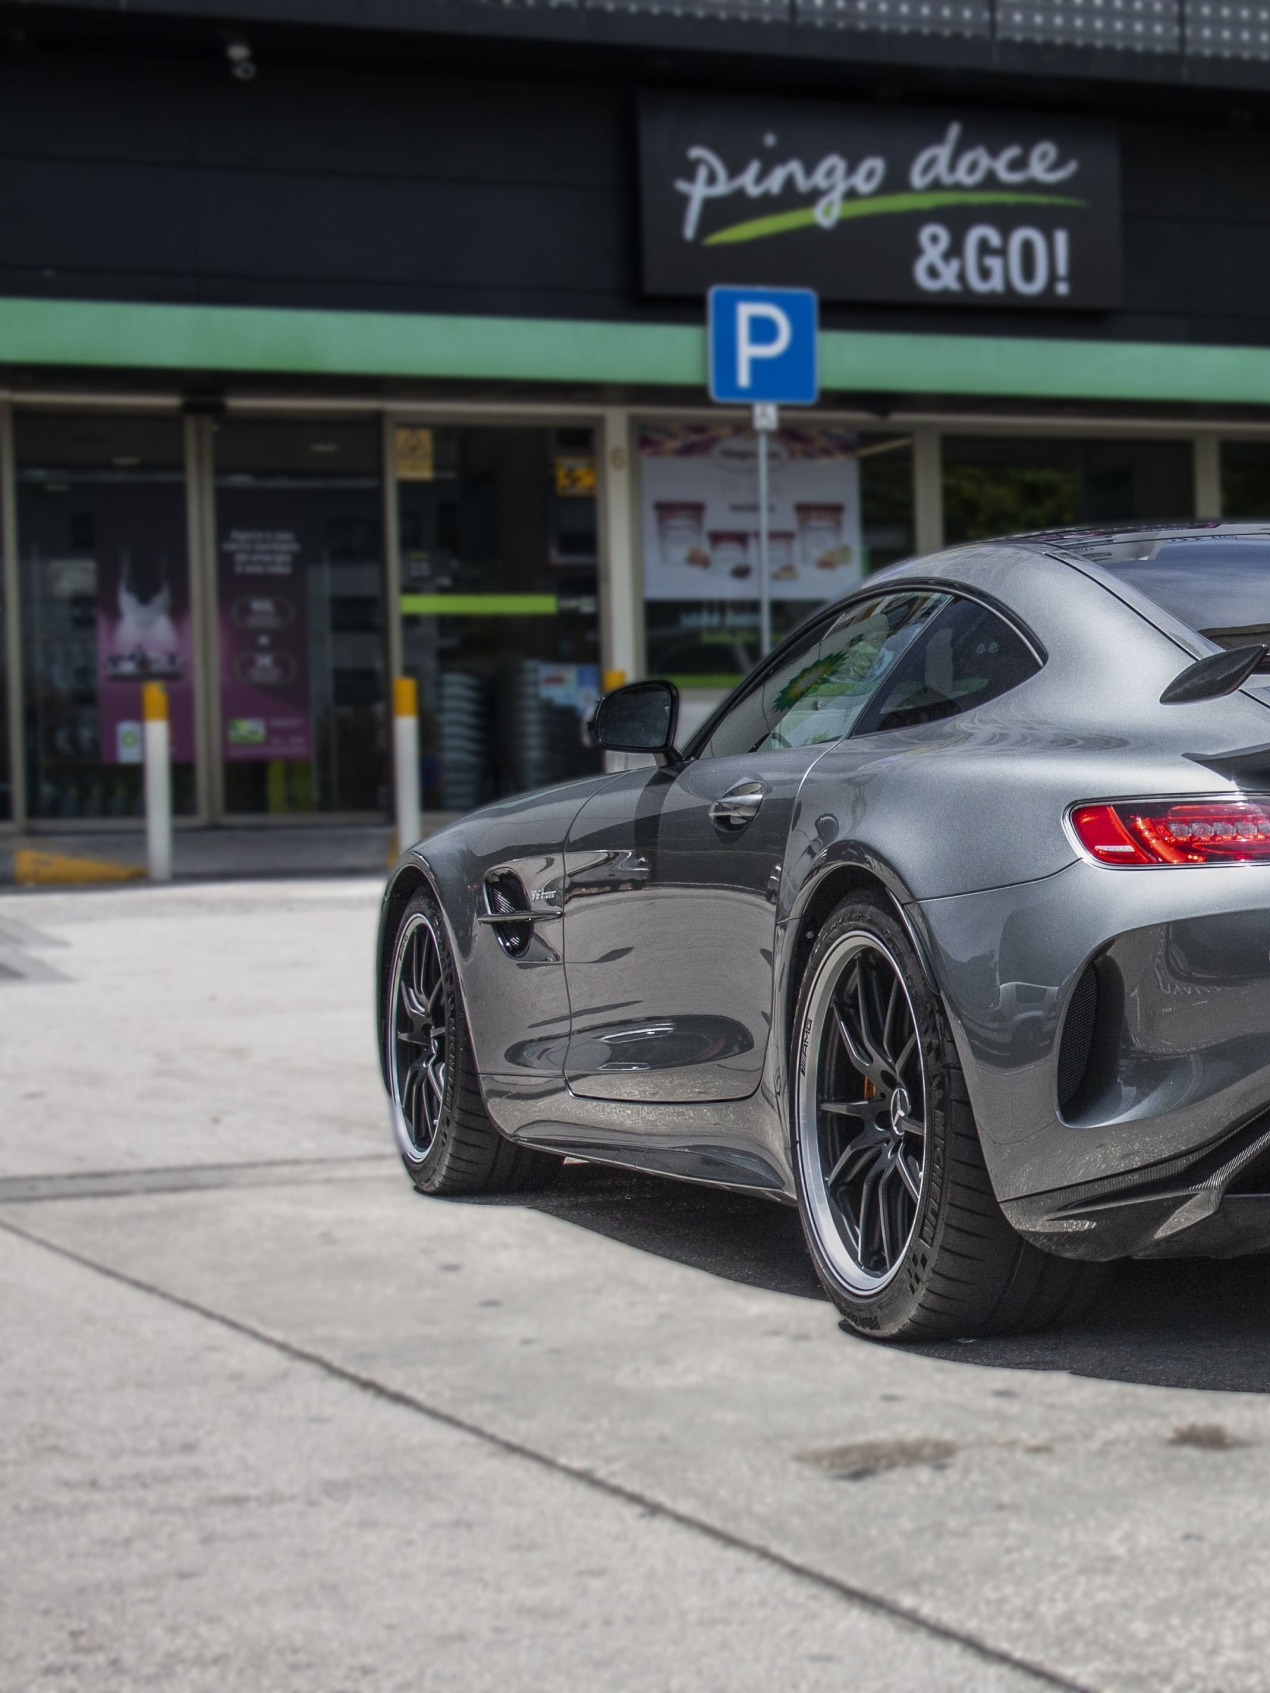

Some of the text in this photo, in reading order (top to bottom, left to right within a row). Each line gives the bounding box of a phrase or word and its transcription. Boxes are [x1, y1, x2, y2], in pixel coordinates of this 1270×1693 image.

[674, 121, 1078, 241] pingo doce
[914, 223, 1071, 297] &GO!
[736, 302, 792, 389] P
[919, 1108, 945, 1250] MICHELIN
